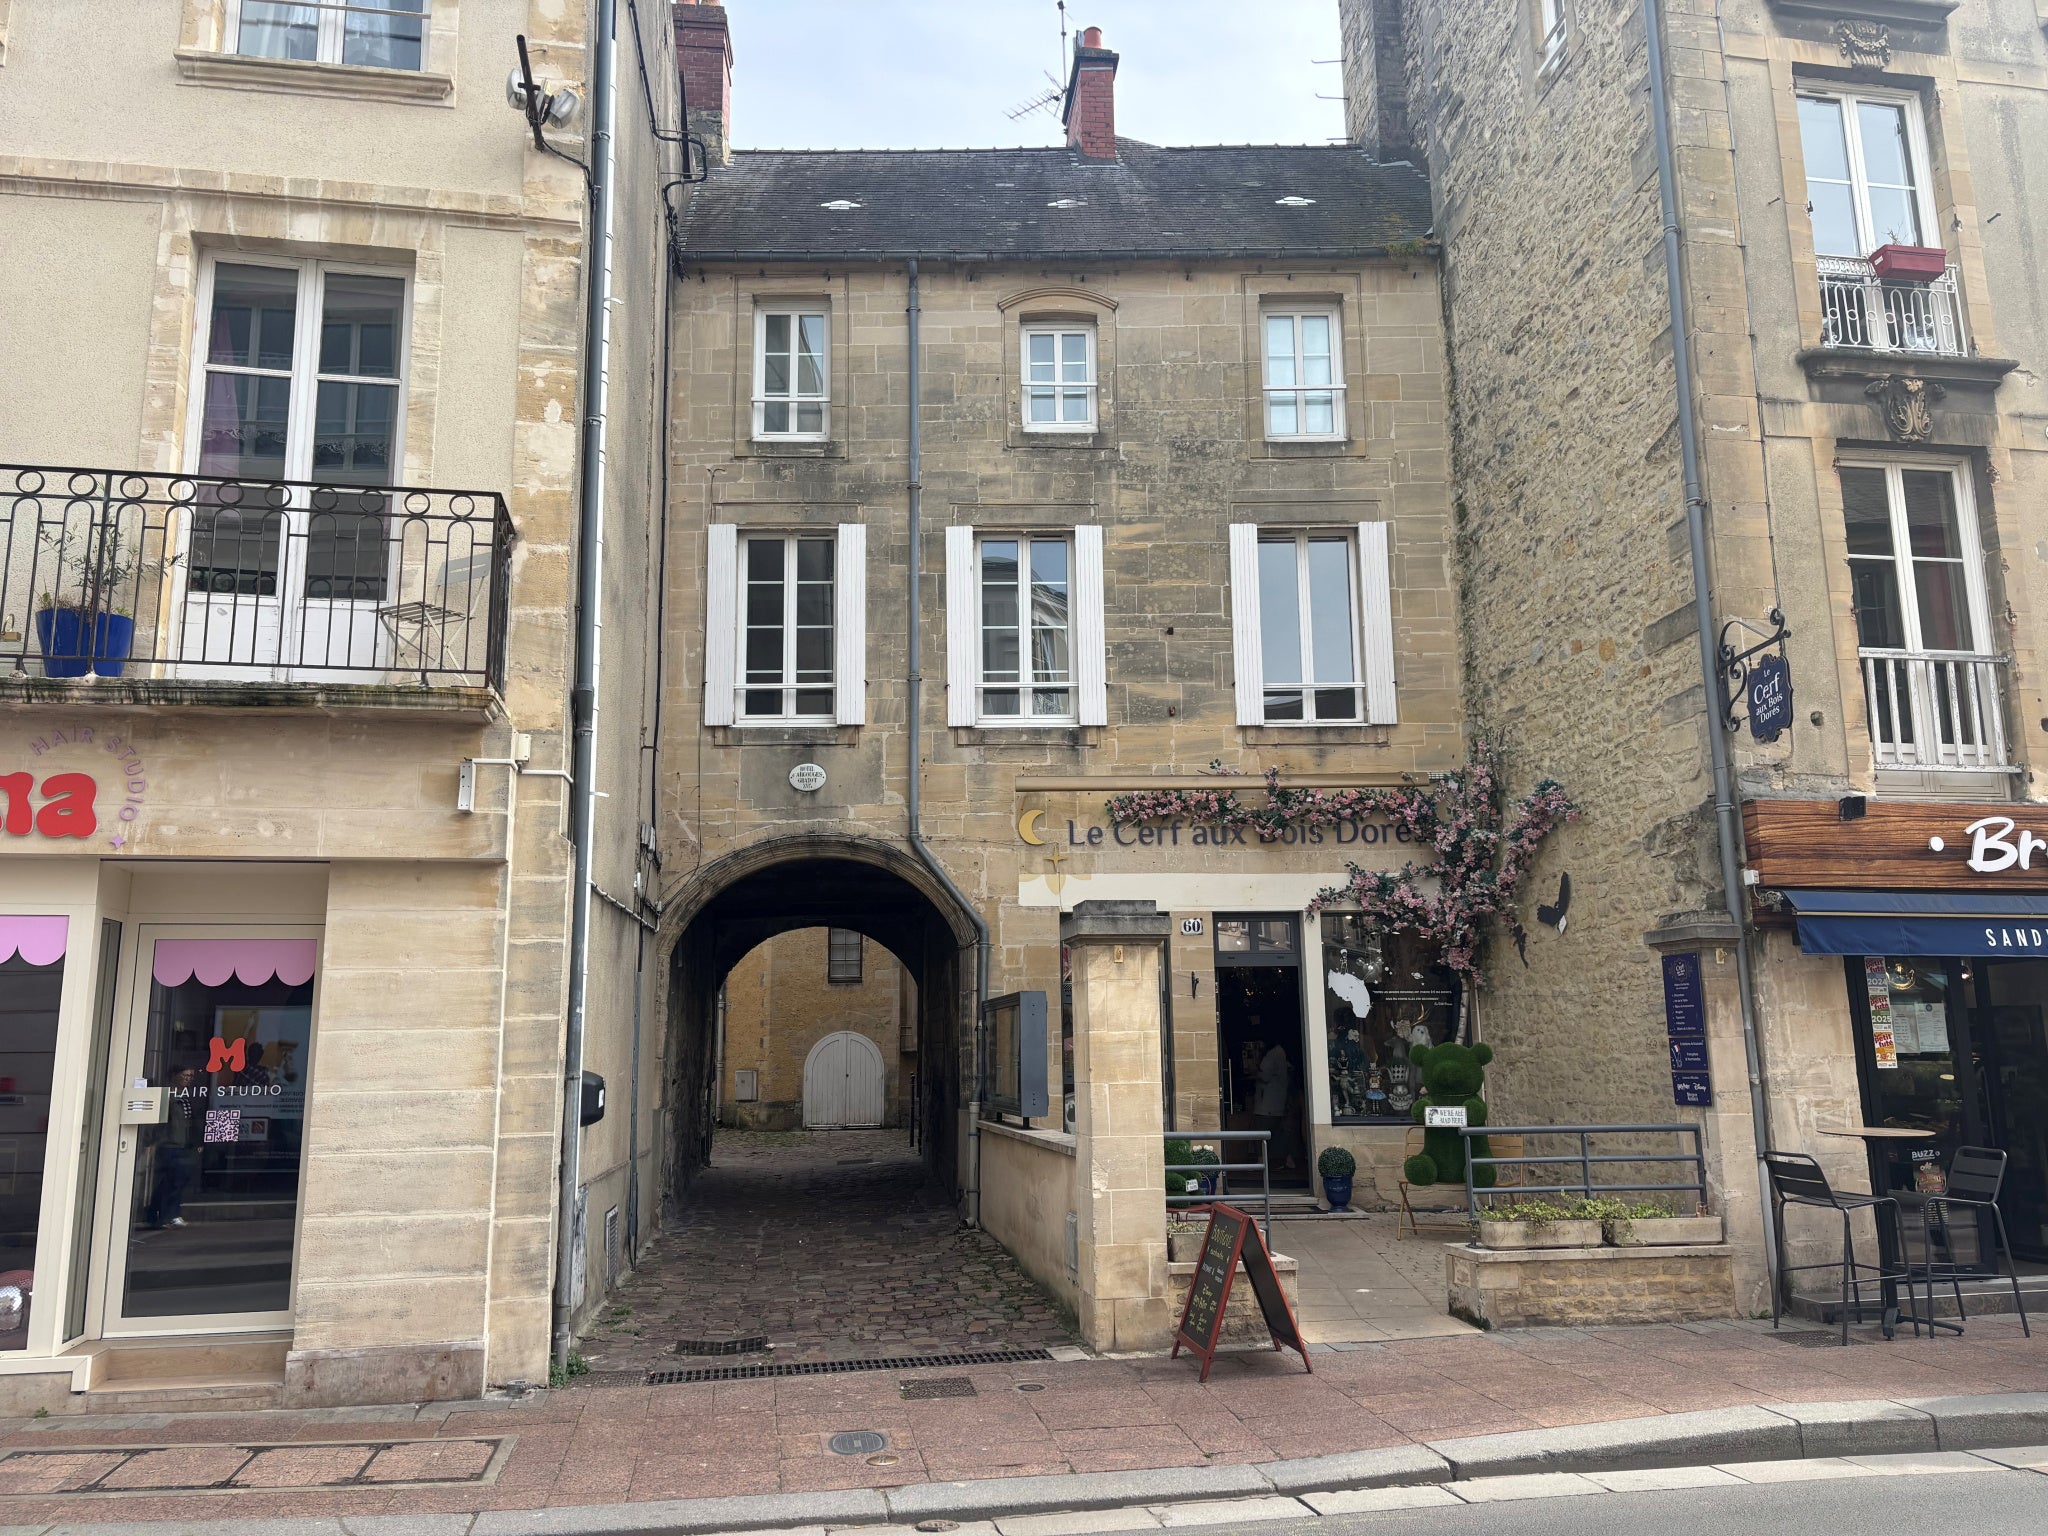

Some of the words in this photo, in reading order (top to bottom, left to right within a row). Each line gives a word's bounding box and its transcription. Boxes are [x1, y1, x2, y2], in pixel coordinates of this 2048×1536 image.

[1763, 669, 1771, 678] Le
[1754, 672, 1780, 705] Cerf
[1756, 703, 1768, 716] aux
[1768, 692, 1783, 708] Bois
[1760, 705, 1780, 723] Dorés
[30, 724, 95, 756] HAIR
[104, 736, 146, 822] STUDIO
[1066, 819, 1103, 846] Le
[1114, 818, 1183, 846] Cerf
[1192, 824, 1248, 846] aux
[1964, 816, 2048, 872] Br
[1183, 920, 1201, 933] 60
[1985, 928, 2048, 947] SAND
[1871, 1015, 1892, 1023] 2025
[206, 1037, 246, 1072] M
[167, 1086, 208, 1098] HAIR
[217, 1085, 282, 1097] STUDIO
[1911, 1149, 1935, 1159] BUZZ
